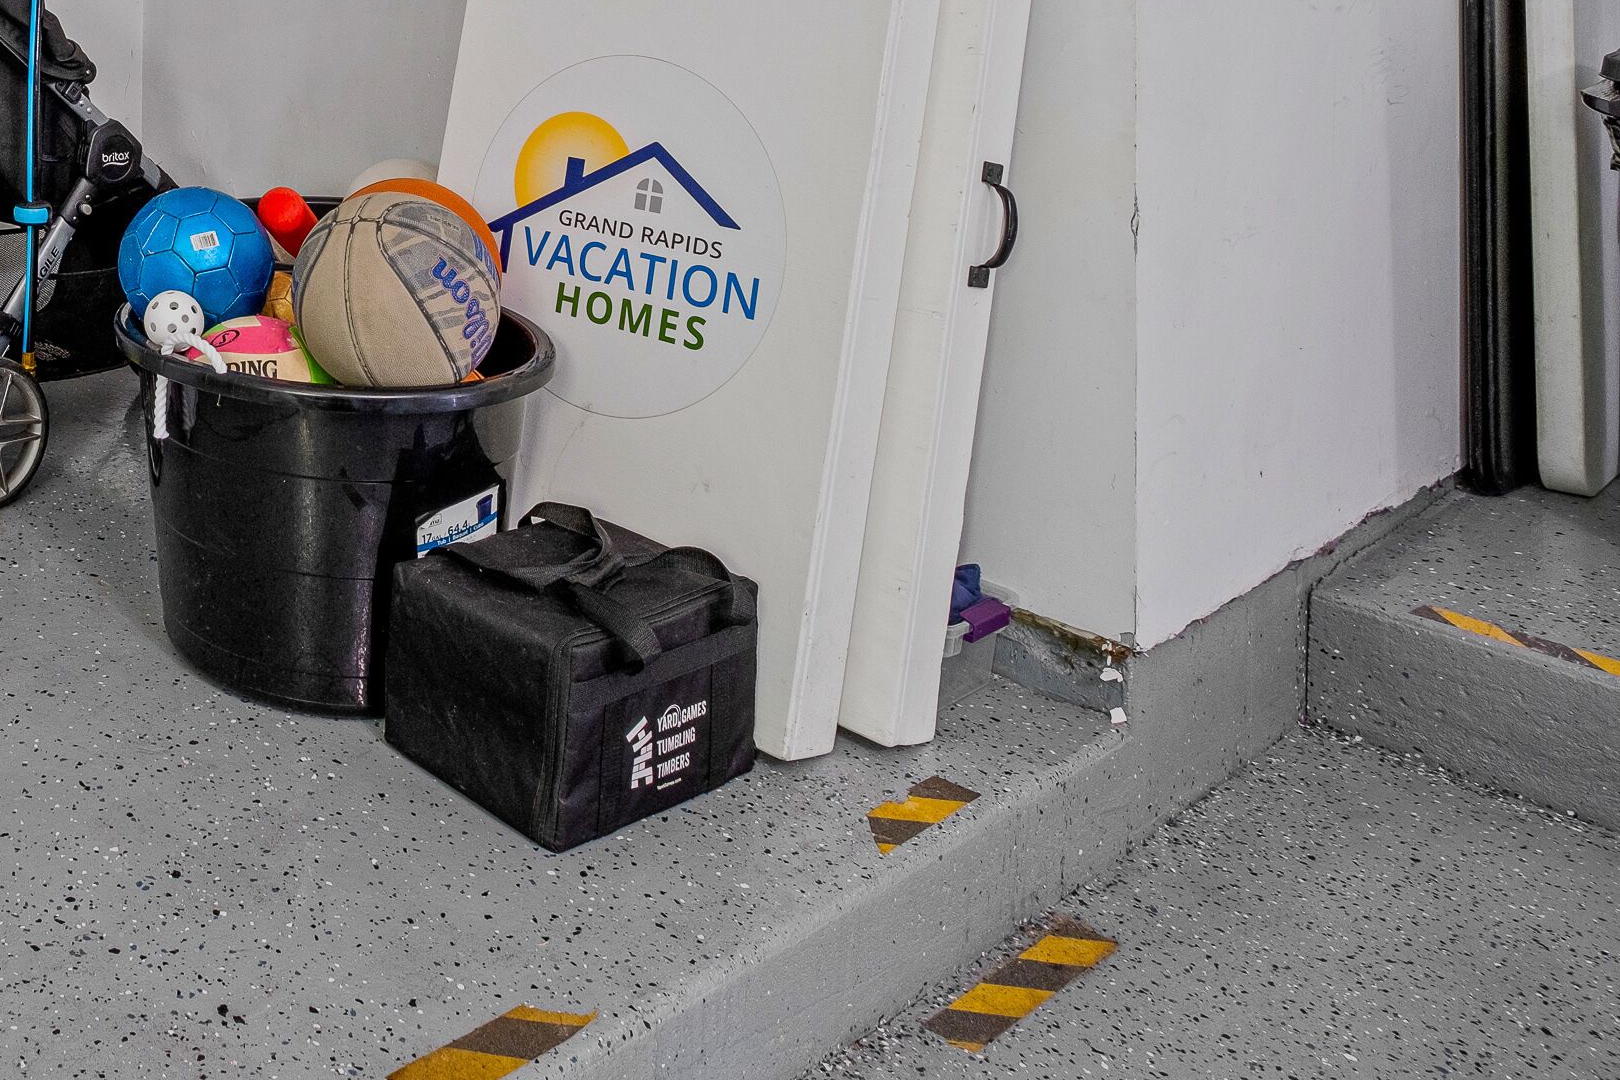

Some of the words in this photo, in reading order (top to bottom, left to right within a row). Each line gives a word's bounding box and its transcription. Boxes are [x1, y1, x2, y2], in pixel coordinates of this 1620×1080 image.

[102, 151, 130, 163] britax
[558, 209, 634, 240] GRAND
[640, 226, 723, 259] RAPIDS
[38, 246, 60, 280] GILE
[524, 225, 761, 321] VACATION
[555, 281, 707, 351] HOMES
[226, 359, 278, 380] DING
[657, 712, 679, 733] YARD
[681, 700, 707, 723] GAMES
[656, 726, 696, 756] TUMBLING
[656, 752, 690, 779] TIMBERS
